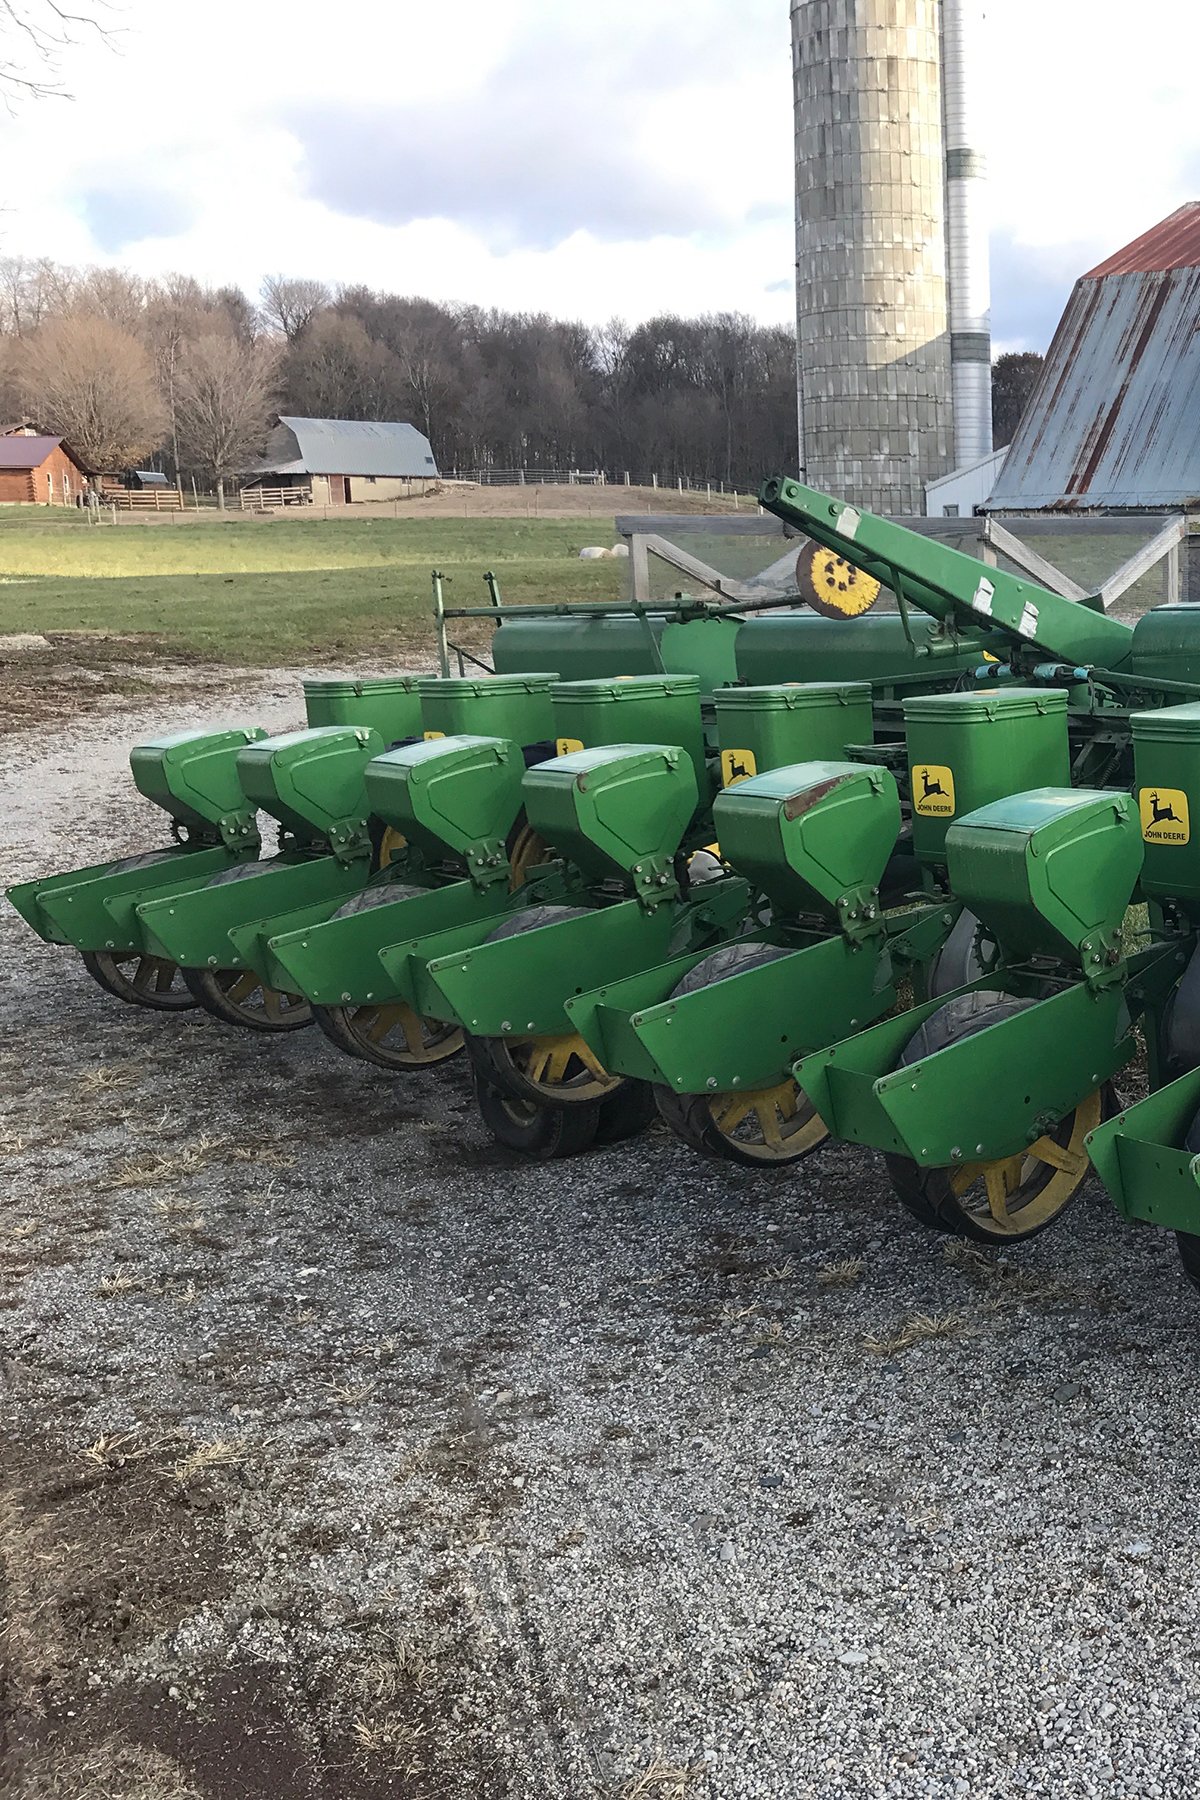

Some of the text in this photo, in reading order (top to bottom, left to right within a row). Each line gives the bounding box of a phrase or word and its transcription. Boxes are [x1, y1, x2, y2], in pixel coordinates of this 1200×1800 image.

[931, 805, 952, 813] DEERE
[1144, 830, 1186, 841] JOHN DEERE
